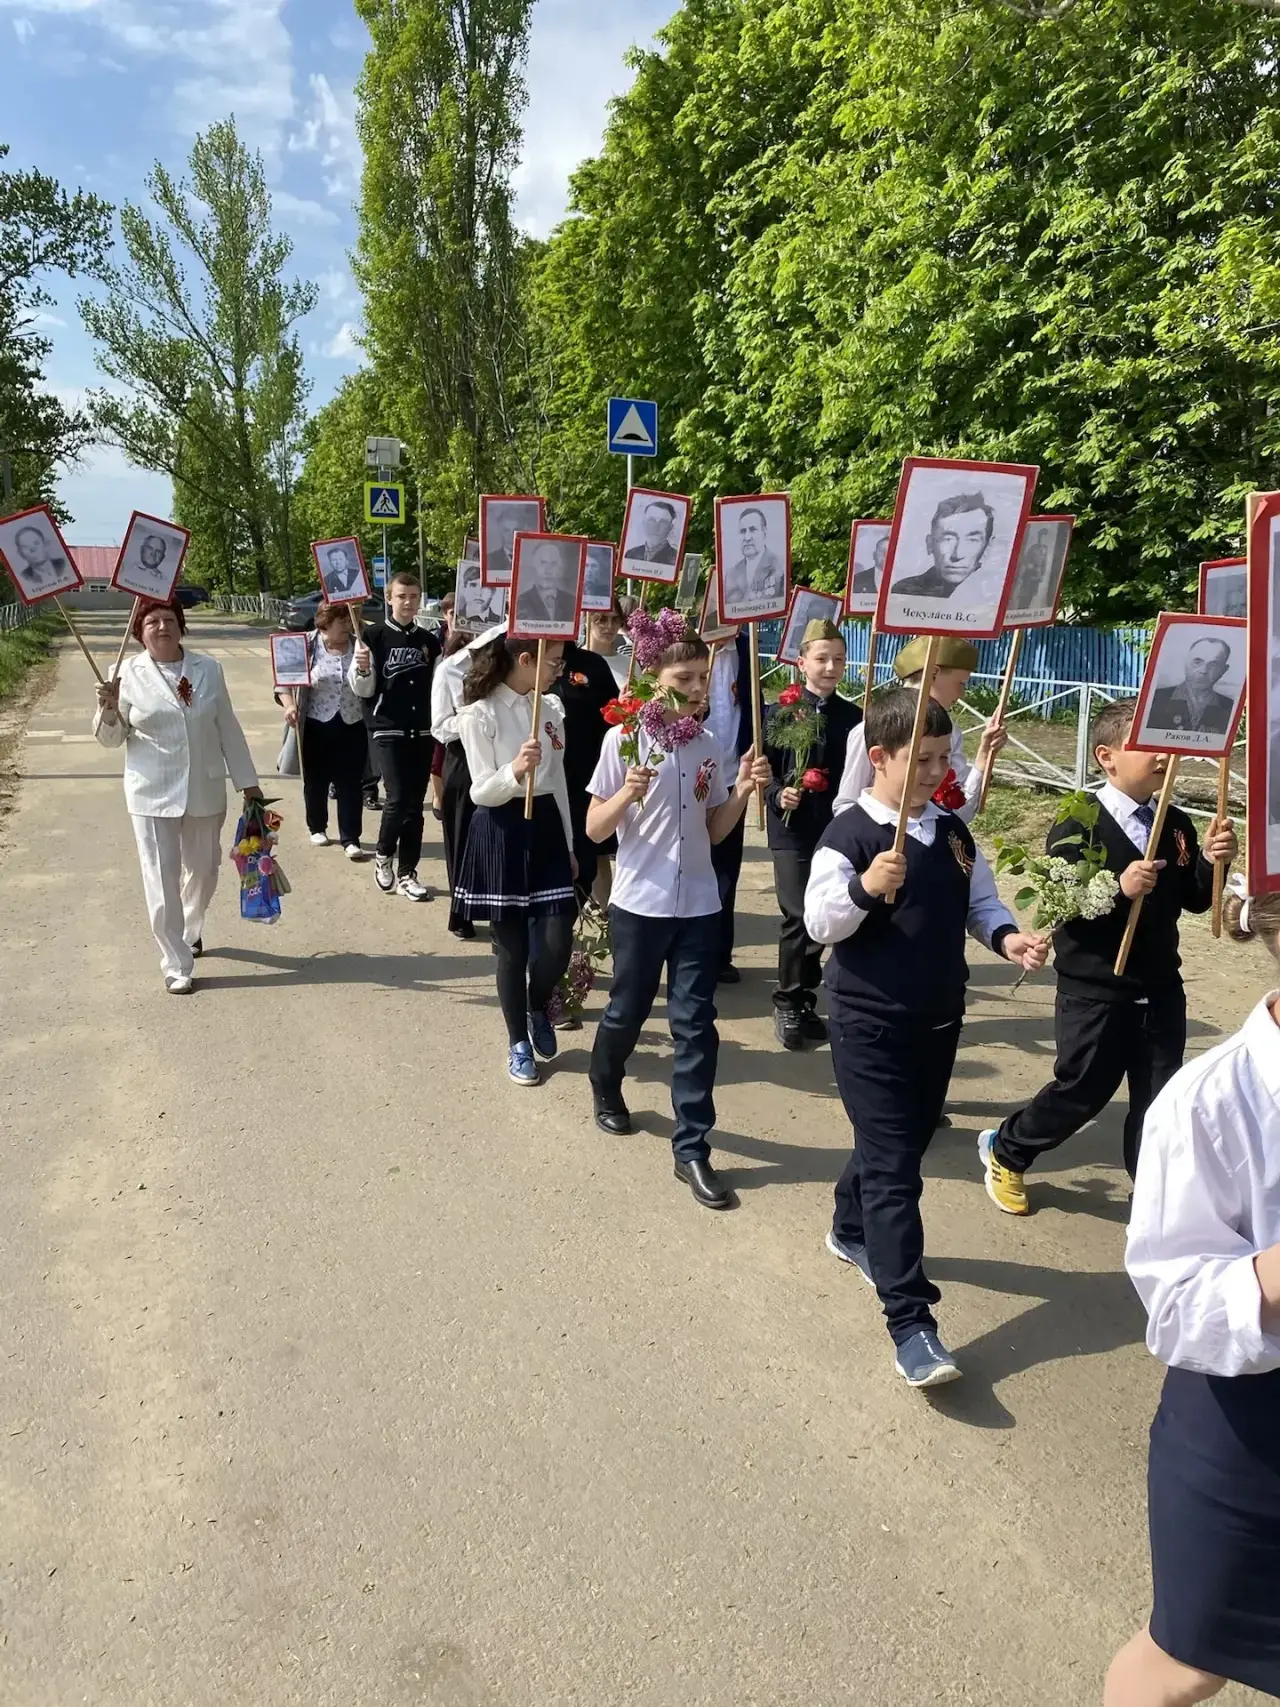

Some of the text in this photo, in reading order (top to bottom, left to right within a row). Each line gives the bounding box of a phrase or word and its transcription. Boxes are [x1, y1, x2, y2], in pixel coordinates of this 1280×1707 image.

[902, 607, 977, 623] Чекулаев В.С.
[388, 647, 425, 665] NIKE
[1165, 731, 1191, 742] Раков
